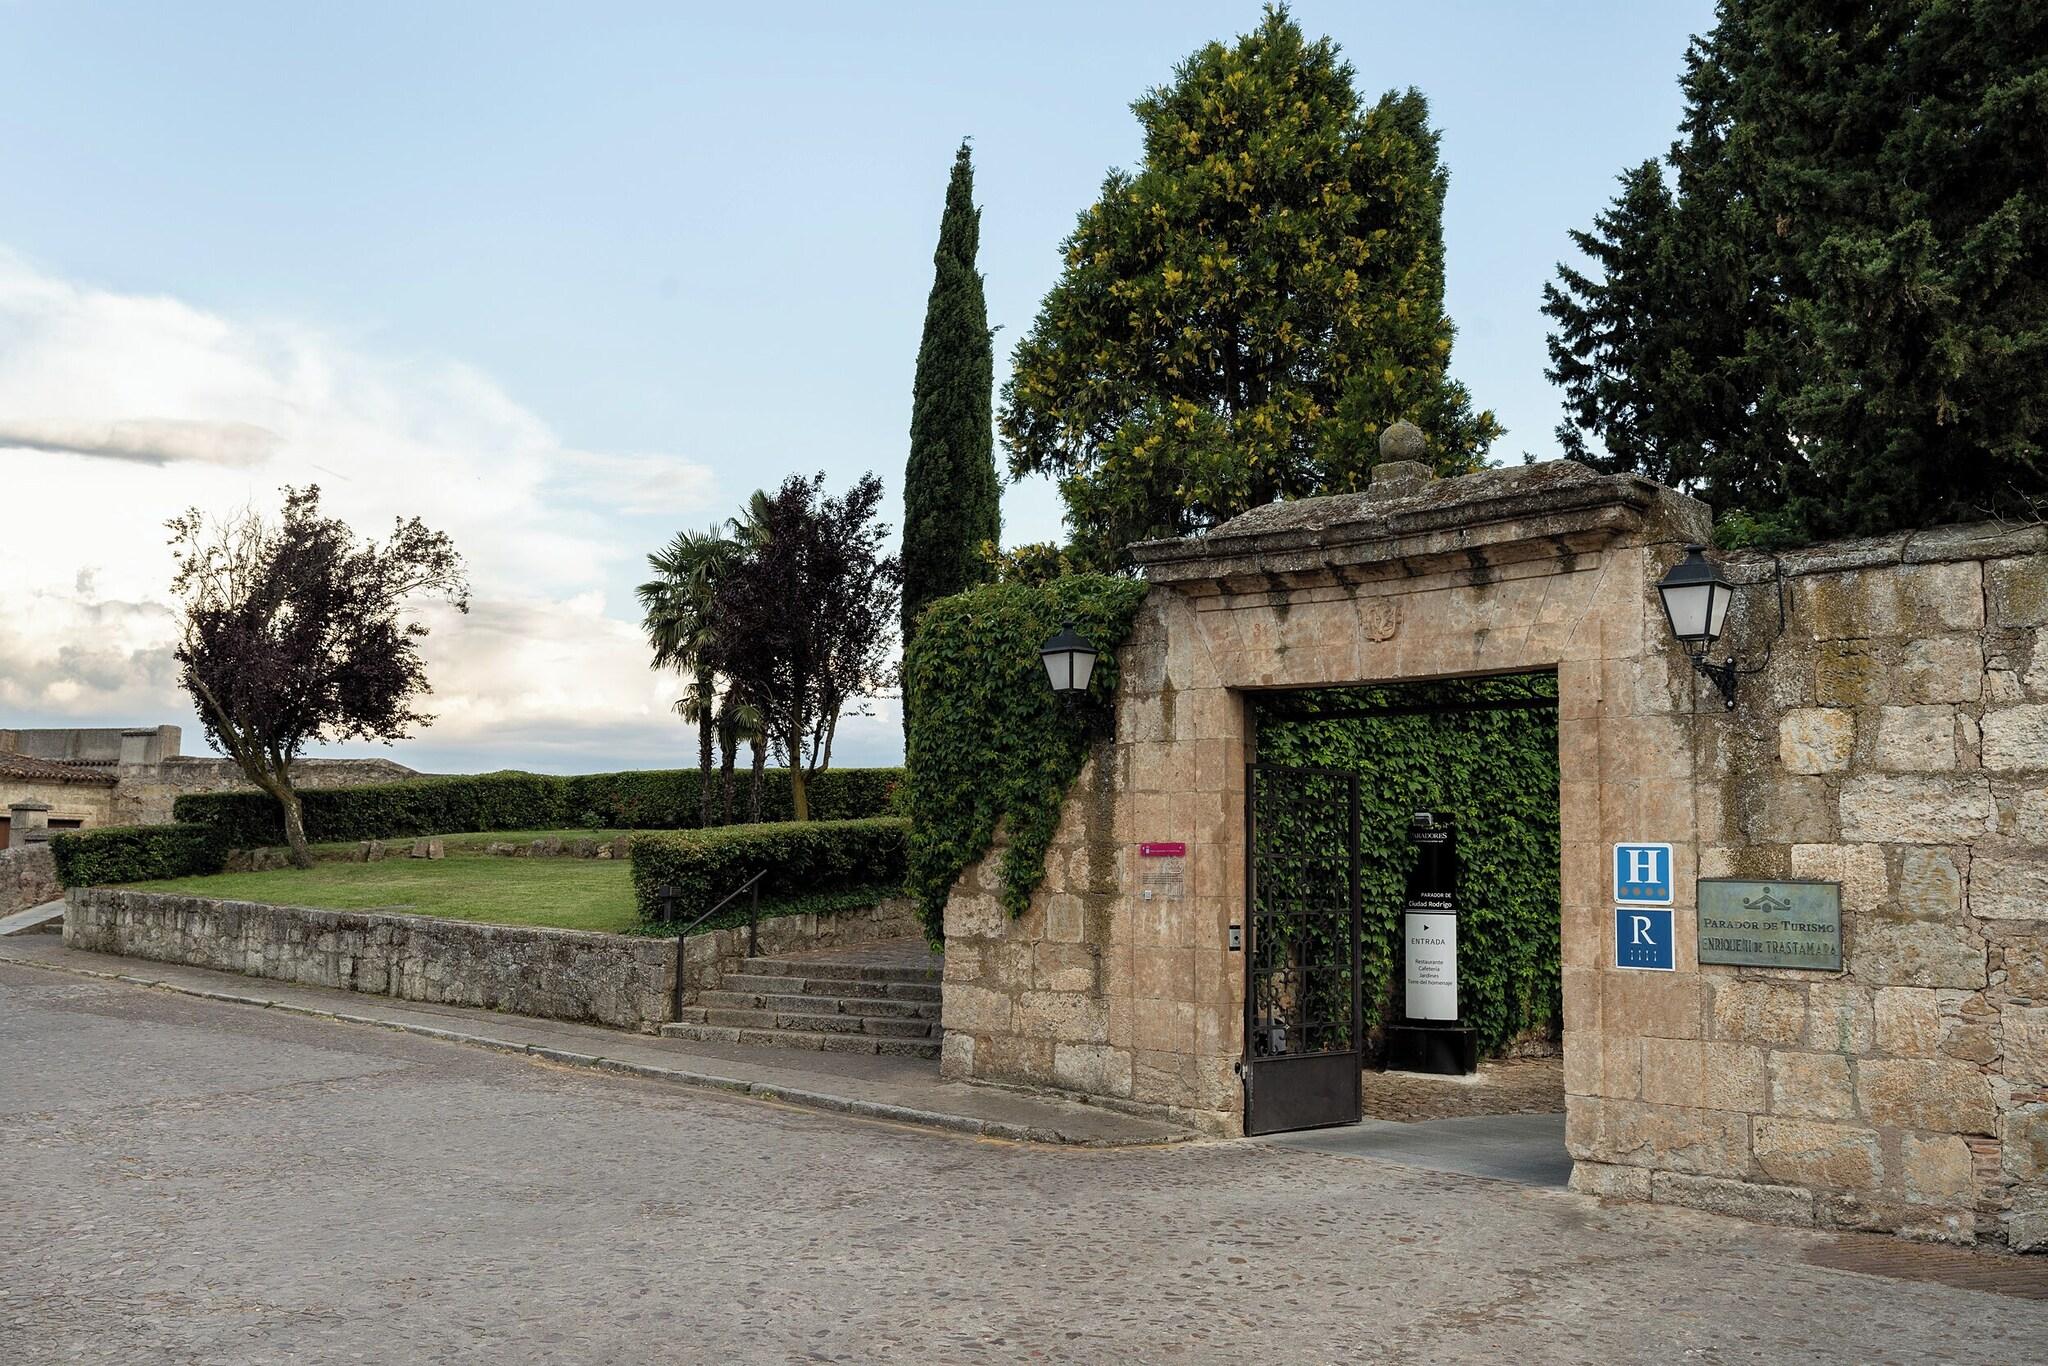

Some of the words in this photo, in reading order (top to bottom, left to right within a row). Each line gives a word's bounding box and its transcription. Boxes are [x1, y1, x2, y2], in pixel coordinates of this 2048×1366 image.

[1626, 850, 1661, 884] H
[1428, 900, 1453, 909] Rodrigo
[1630, 916, 1656, 945] R
[1703, 918, 1759, 930] PARADOR
[1763, 922, 1777, 930] DE
[1781, 920, 1835, 933] TURISMO
[1703, 937, 1742, 952] ENRIQUE
[1428, 979, 1453, 987] homenaje
